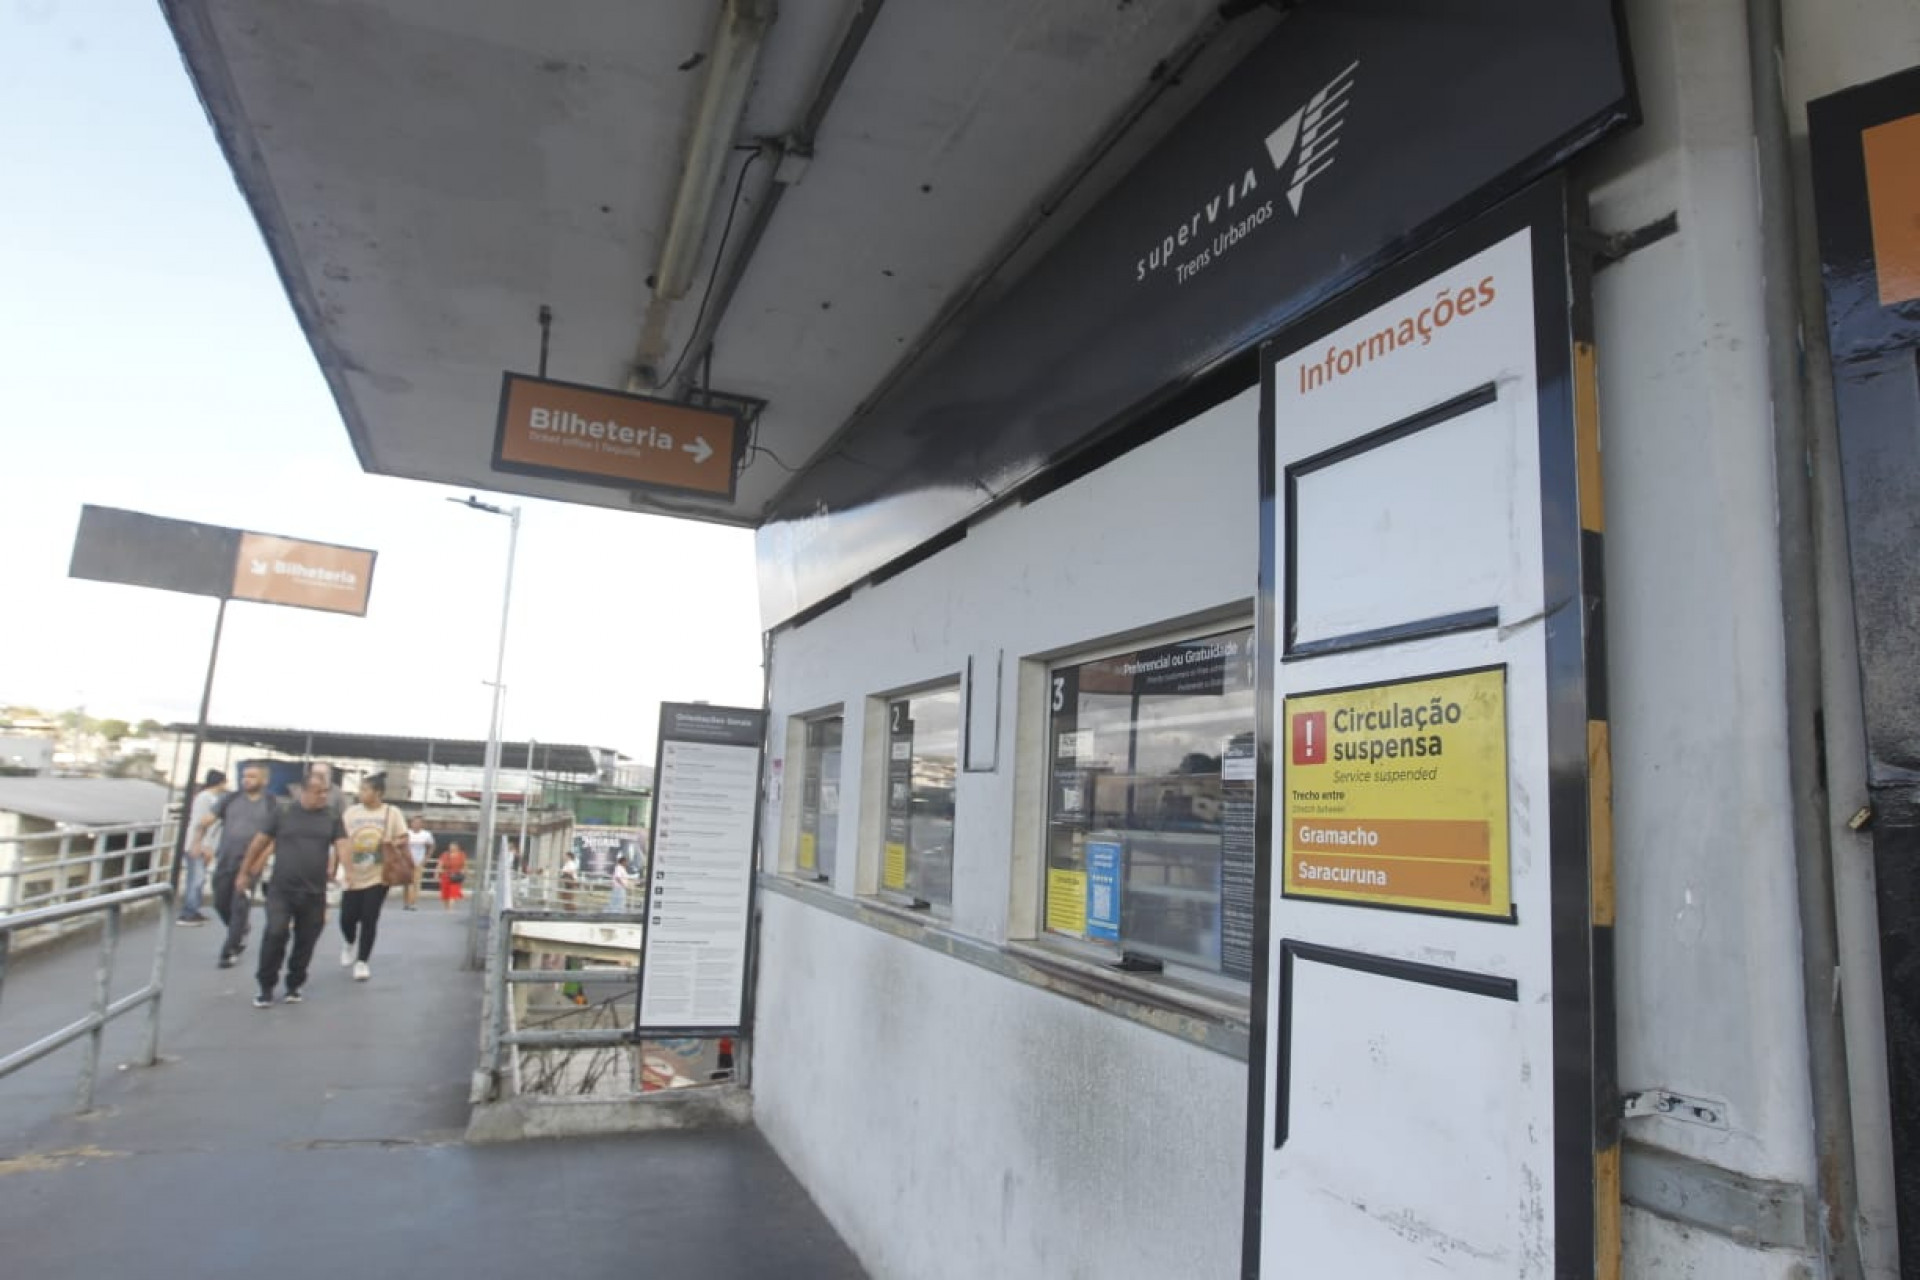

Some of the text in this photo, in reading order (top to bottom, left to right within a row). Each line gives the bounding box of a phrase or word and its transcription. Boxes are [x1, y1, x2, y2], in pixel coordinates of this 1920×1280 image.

[1176, 200, 1273, 284] Trens Urbanos
[1300, 275, 1496, 395] Informações
[529, 407, 673, 450] Bilheteria
[275, 560, 356, 584] Bilheteria
[1172, 654, 1184, 666] ou
[1053, 677, 1065, 711] 3
[892, 705, 900, 732] 2
[1333, 697, 1462, 734] Circulação
[1333, 735, 1443, 764] suspensa
[1333, 766, 1438, 784] Service suspended
[1292, 790, 1345, 801] Trecho entre
[1299, 825, 1378, 846] Gramacho
[1299, 861, 1388, 886] Saracuruna
